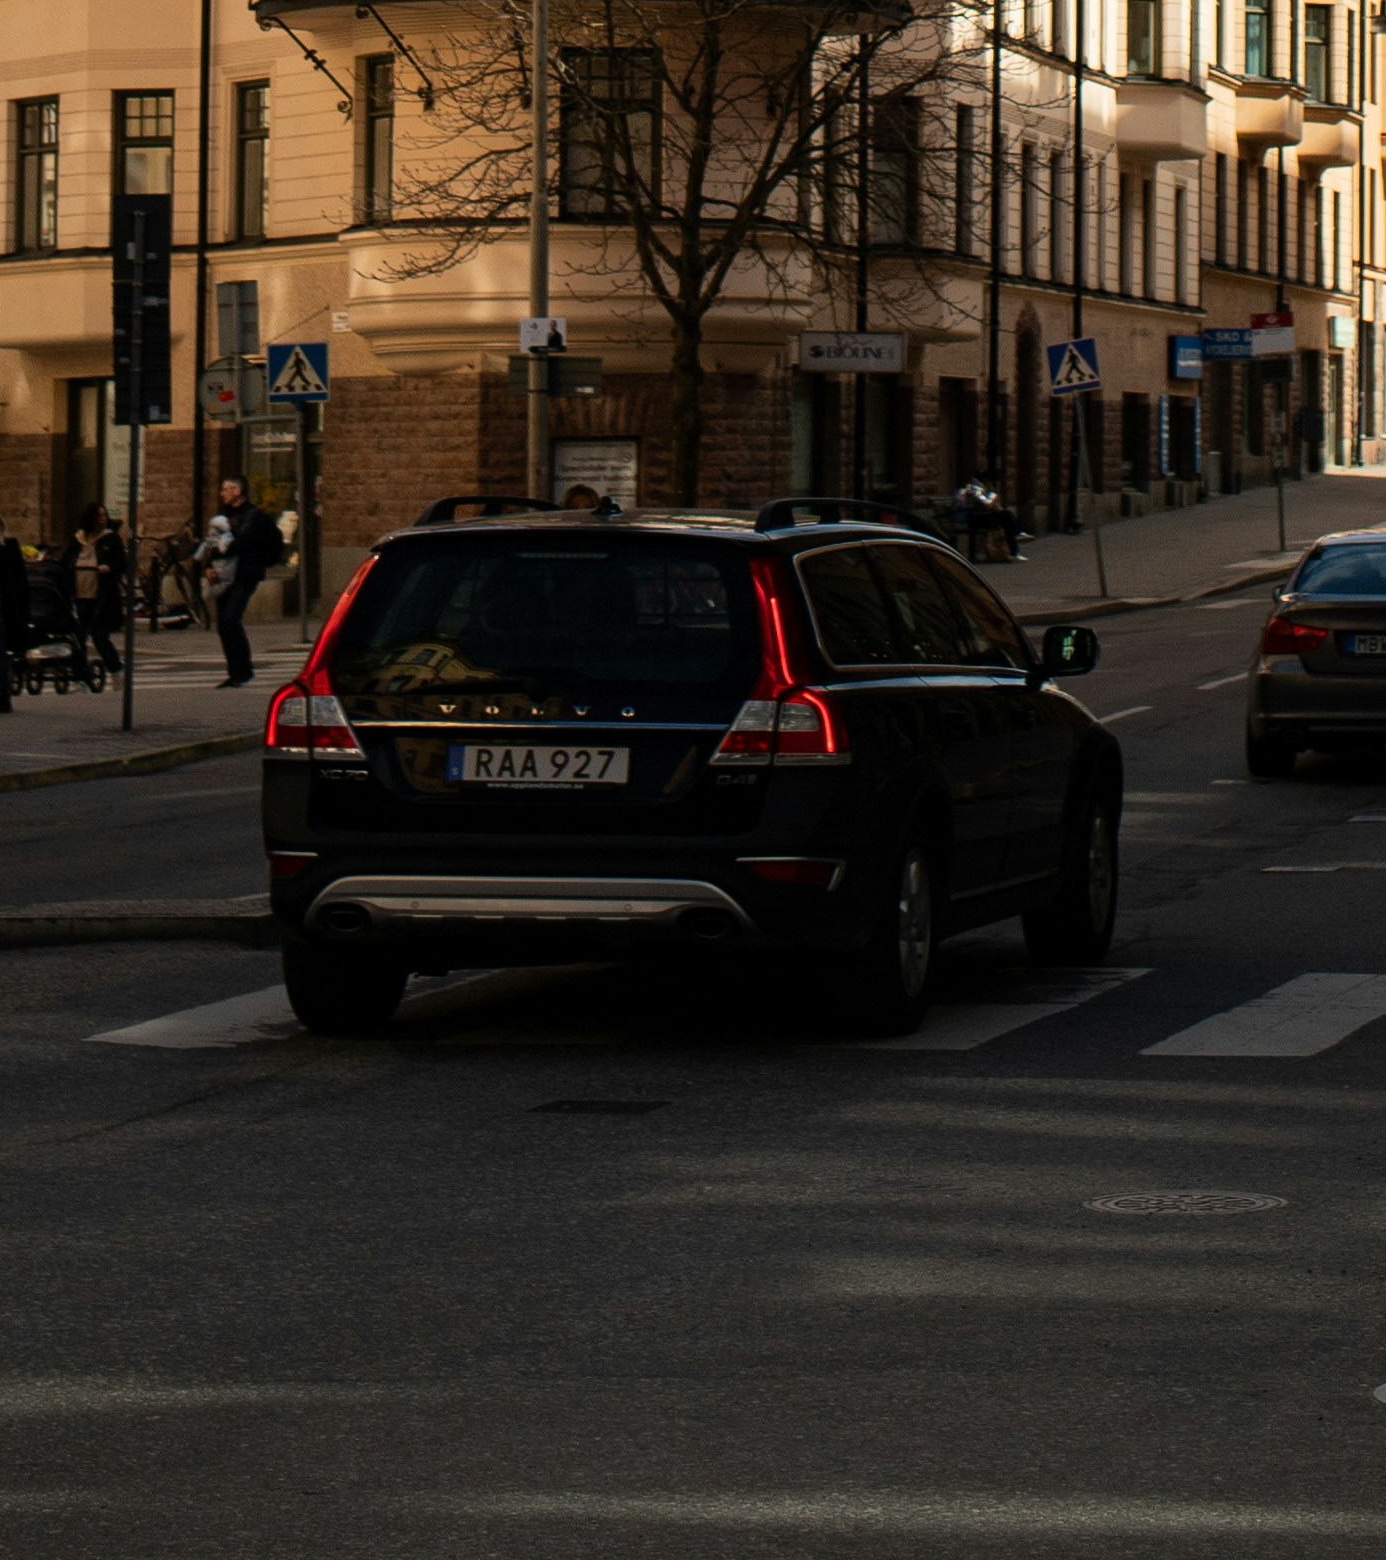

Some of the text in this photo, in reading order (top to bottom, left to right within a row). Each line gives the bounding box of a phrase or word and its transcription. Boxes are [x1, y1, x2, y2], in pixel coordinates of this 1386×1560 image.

[437, 703, 636, 718] VOLVO
[475, 748, 616, 779] RAA 927
